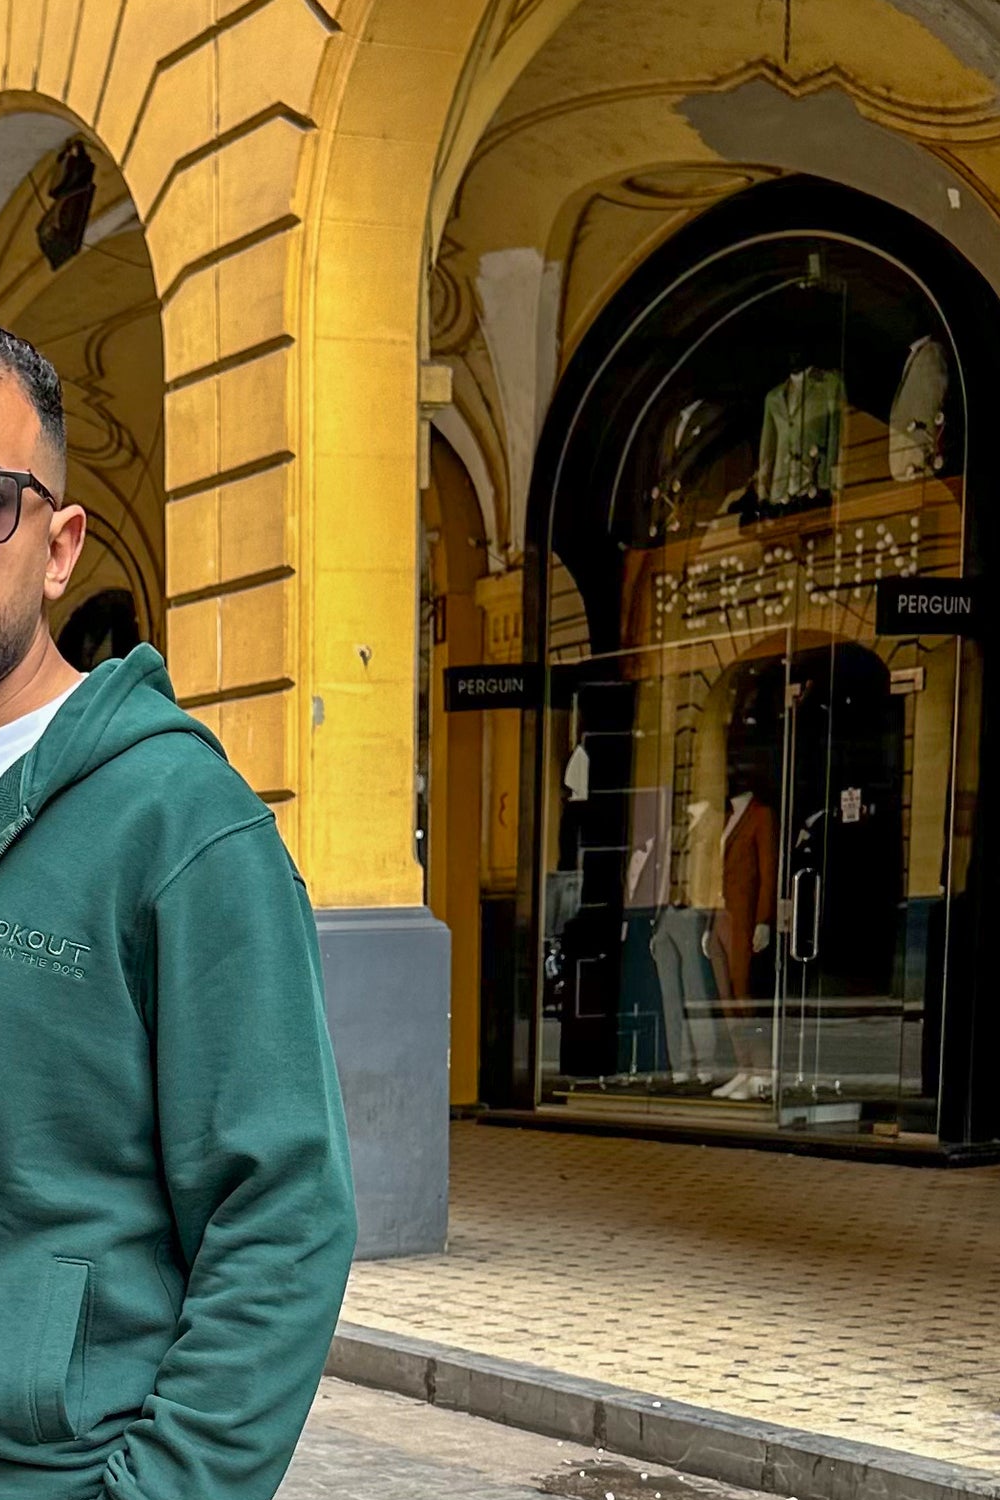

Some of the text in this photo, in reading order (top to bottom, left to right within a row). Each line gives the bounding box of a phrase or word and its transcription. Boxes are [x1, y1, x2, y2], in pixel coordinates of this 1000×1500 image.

[898, 594, 971, 614] PERGUIN
[458, 678, 524, 695] PERGUIN
[1, 946, 16, 960] IN
[20, 951, 48, 968] THE
